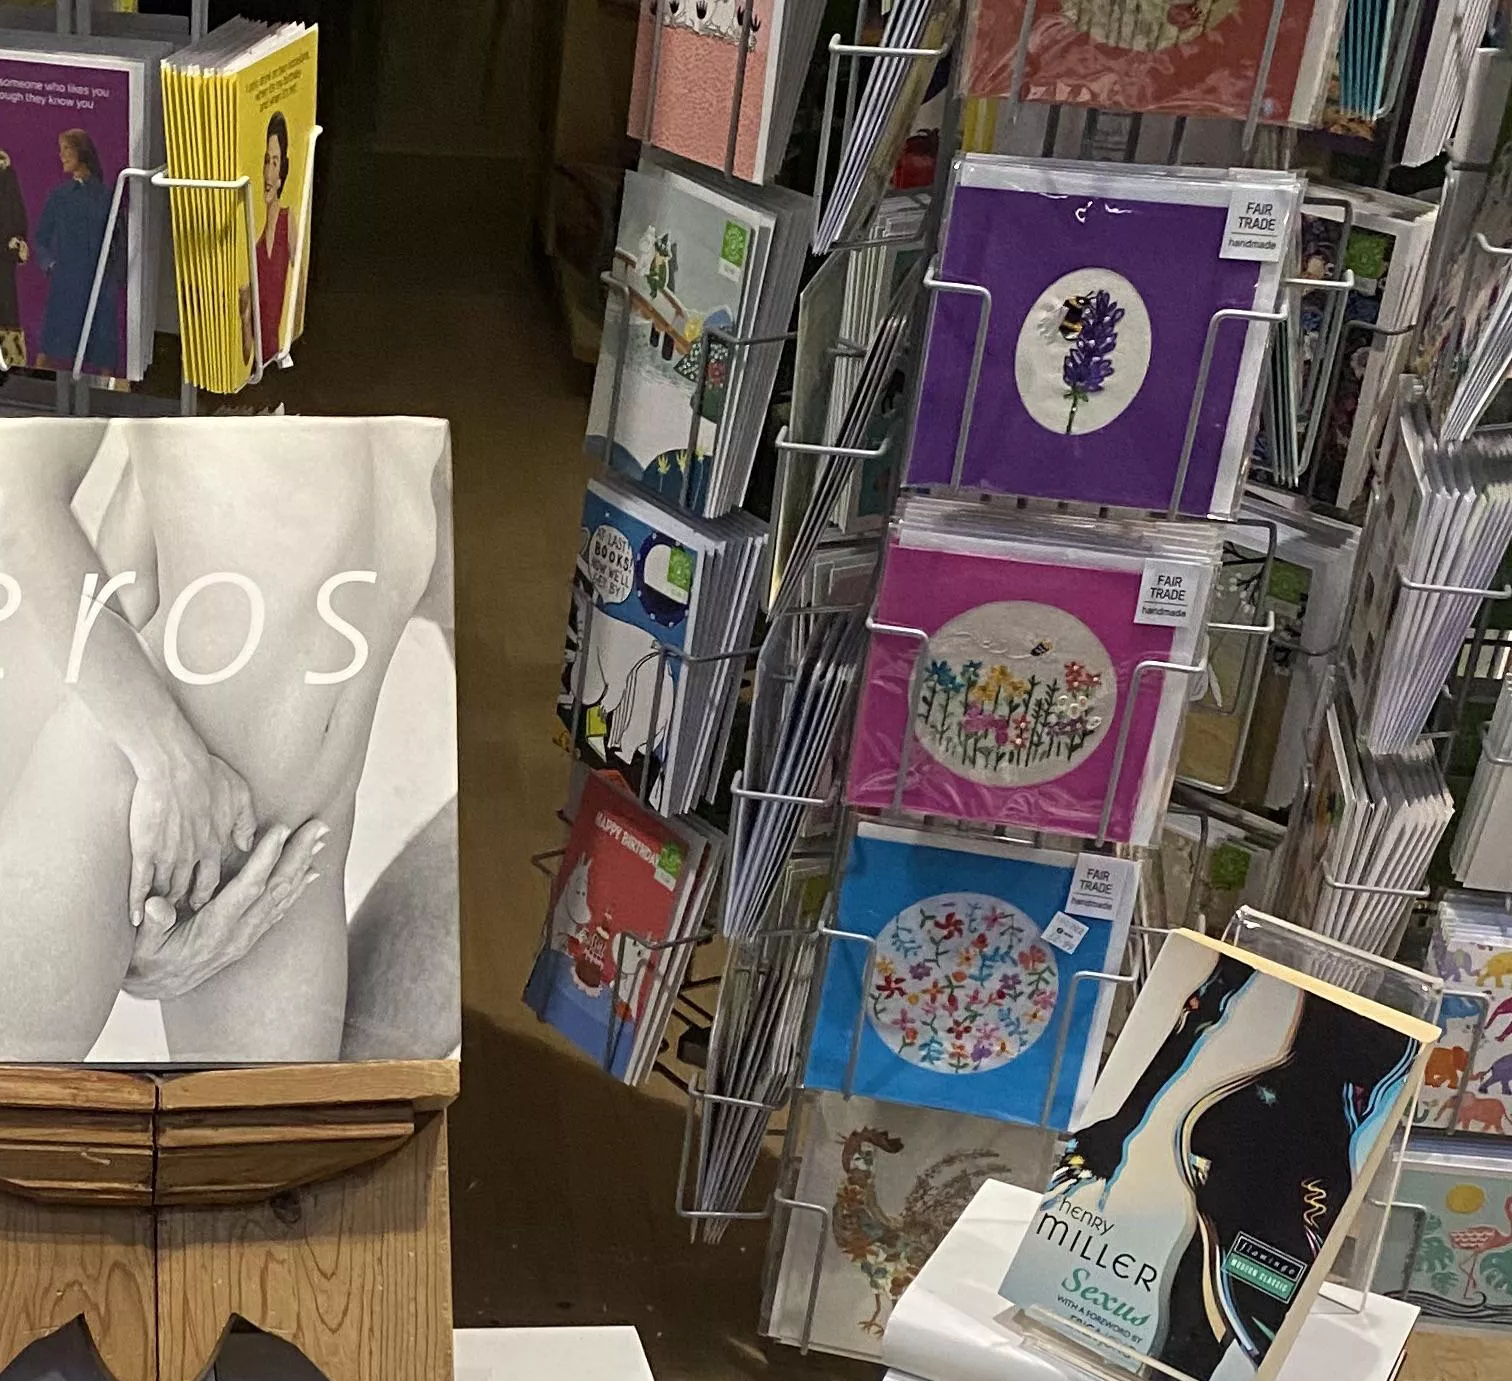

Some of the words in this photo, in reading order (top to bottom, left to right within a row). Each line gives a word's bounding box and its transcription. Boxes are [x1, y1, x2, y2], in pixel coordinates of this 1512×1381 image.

[0, 77, 42, 91] someone
[1246, 202, 1273, 217] FAIR
[1237, 215, 1277, 232] TRADE
[1227, 236, 1276, 252] handmade
[595, 541, 633, 573] BOOKS!
[1157, 574, 1183, 589] FAIR
[1150, 586, 1186, 601] TRADE
[1141, 604, 1187, 618] handmade
[595, 812, 622, 840] HAPPY
[1087, 868, 1110, 881] FAIR
[1080, 880, 1113, 894] TRADE
[1237, 1241, 1296, 1276] flamingo
[1059, 1266, 1152, 1328] Sexus
[1086, 1310, 1130, 1337] FOREWORD
